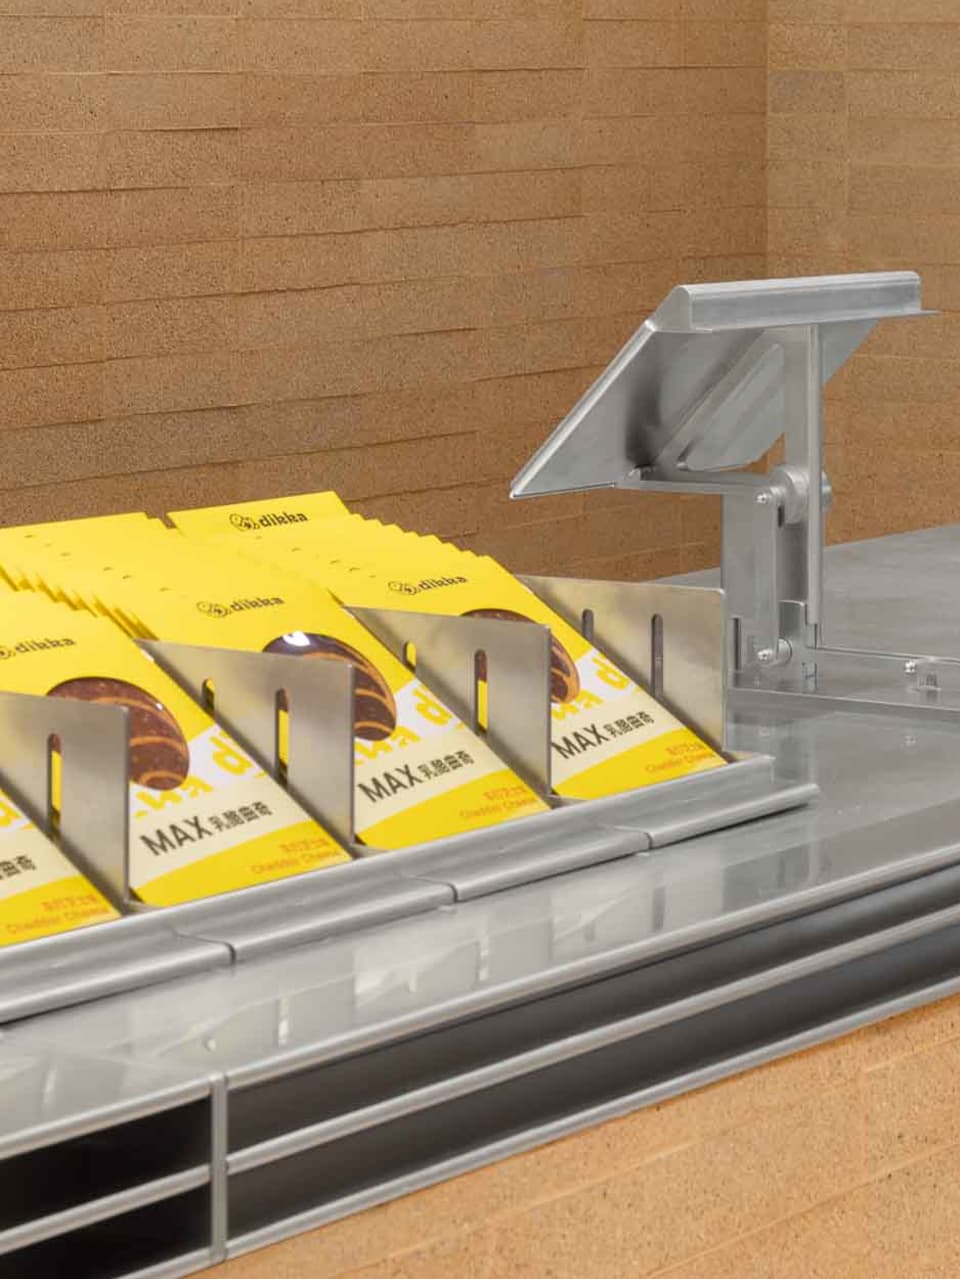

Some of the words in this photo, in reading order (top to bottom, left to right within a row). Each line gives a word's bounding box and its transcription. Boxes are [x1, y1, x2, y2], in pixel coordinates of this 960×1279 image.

[259, 511, 308, 528] dikka
[417, 575, 468, 593] dikka
[230, 595, 284, 613] dikka
[14, 637, 76, 655] dikka
[551, 723, 611, 760] MAX
[358, 764, 423, 803] MAX
[140, 815, 213, 856] MAX
